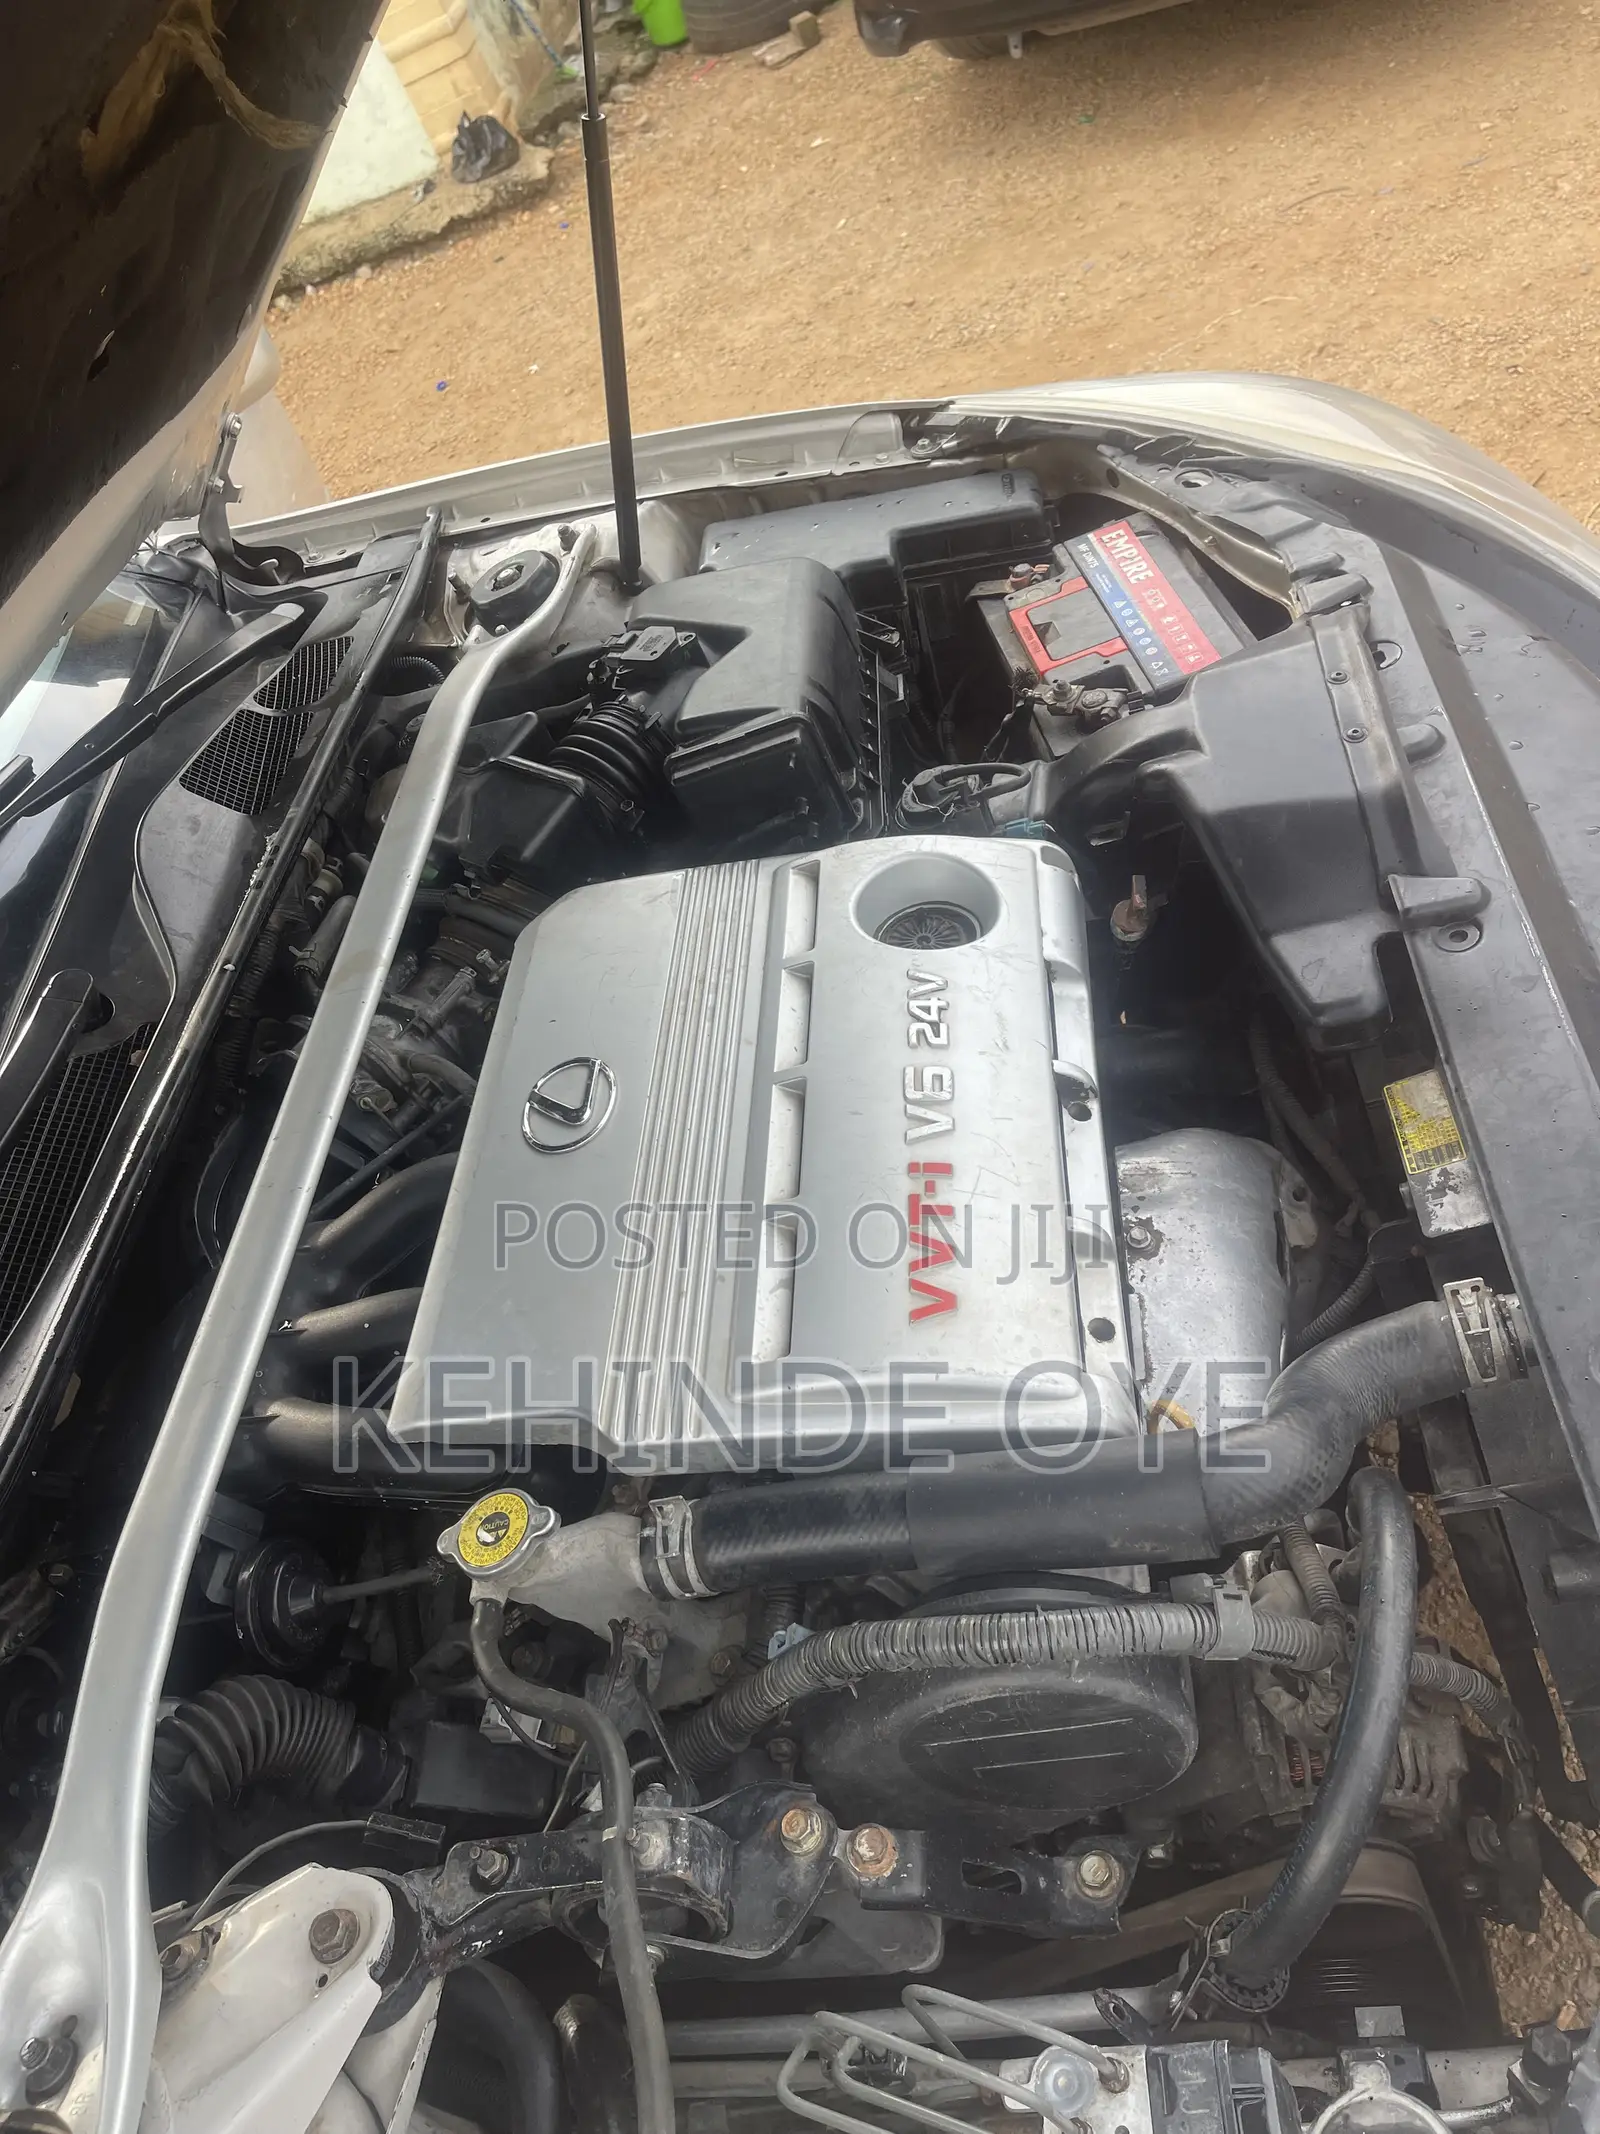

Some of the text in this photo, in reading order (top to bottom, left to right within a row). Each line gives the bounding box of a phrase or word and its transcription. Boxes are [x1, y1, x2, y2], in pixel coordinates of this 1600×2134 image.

[1101, 529, 1154, 584] EMPIRE
[904, 968, 958, 1326] VVT-i V6 24V
